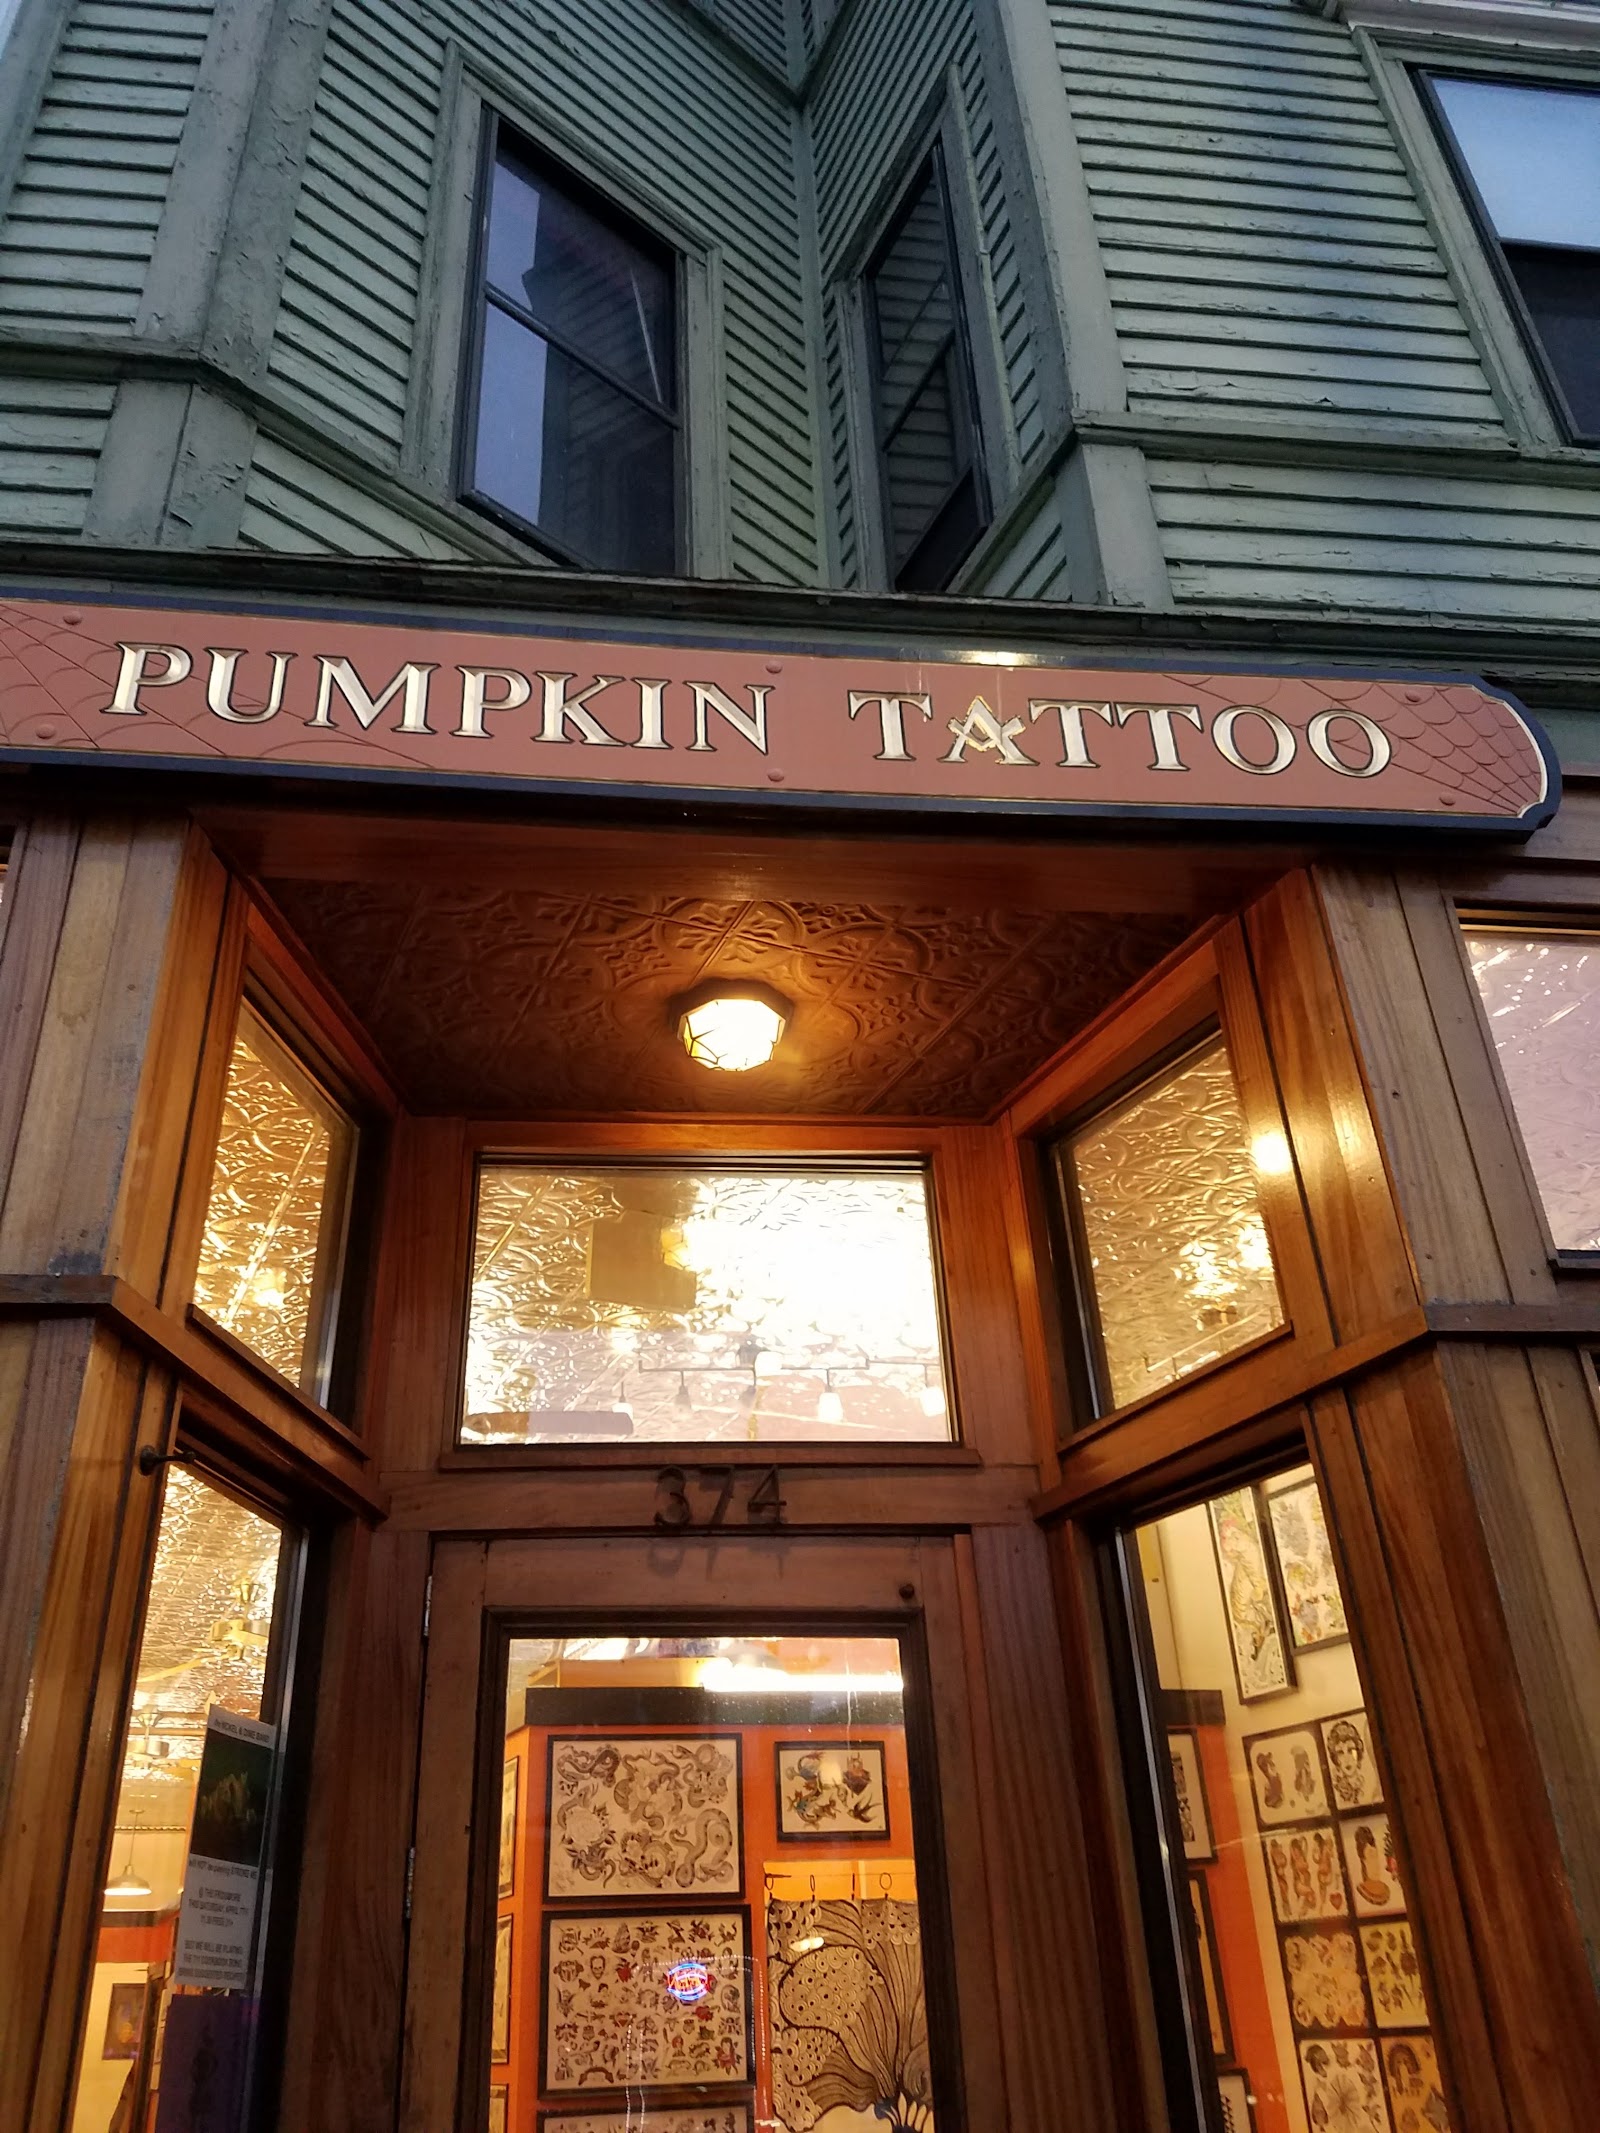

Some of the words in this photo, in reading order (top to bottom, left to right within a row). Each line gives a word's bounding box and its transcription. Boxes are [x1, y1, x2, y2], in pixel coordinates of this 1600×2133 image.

[101, 641, 774, 755] PUMPKIN
[848, 690, 1392, 778] TATTOO
[653, 1465, 788, 1530] 374
